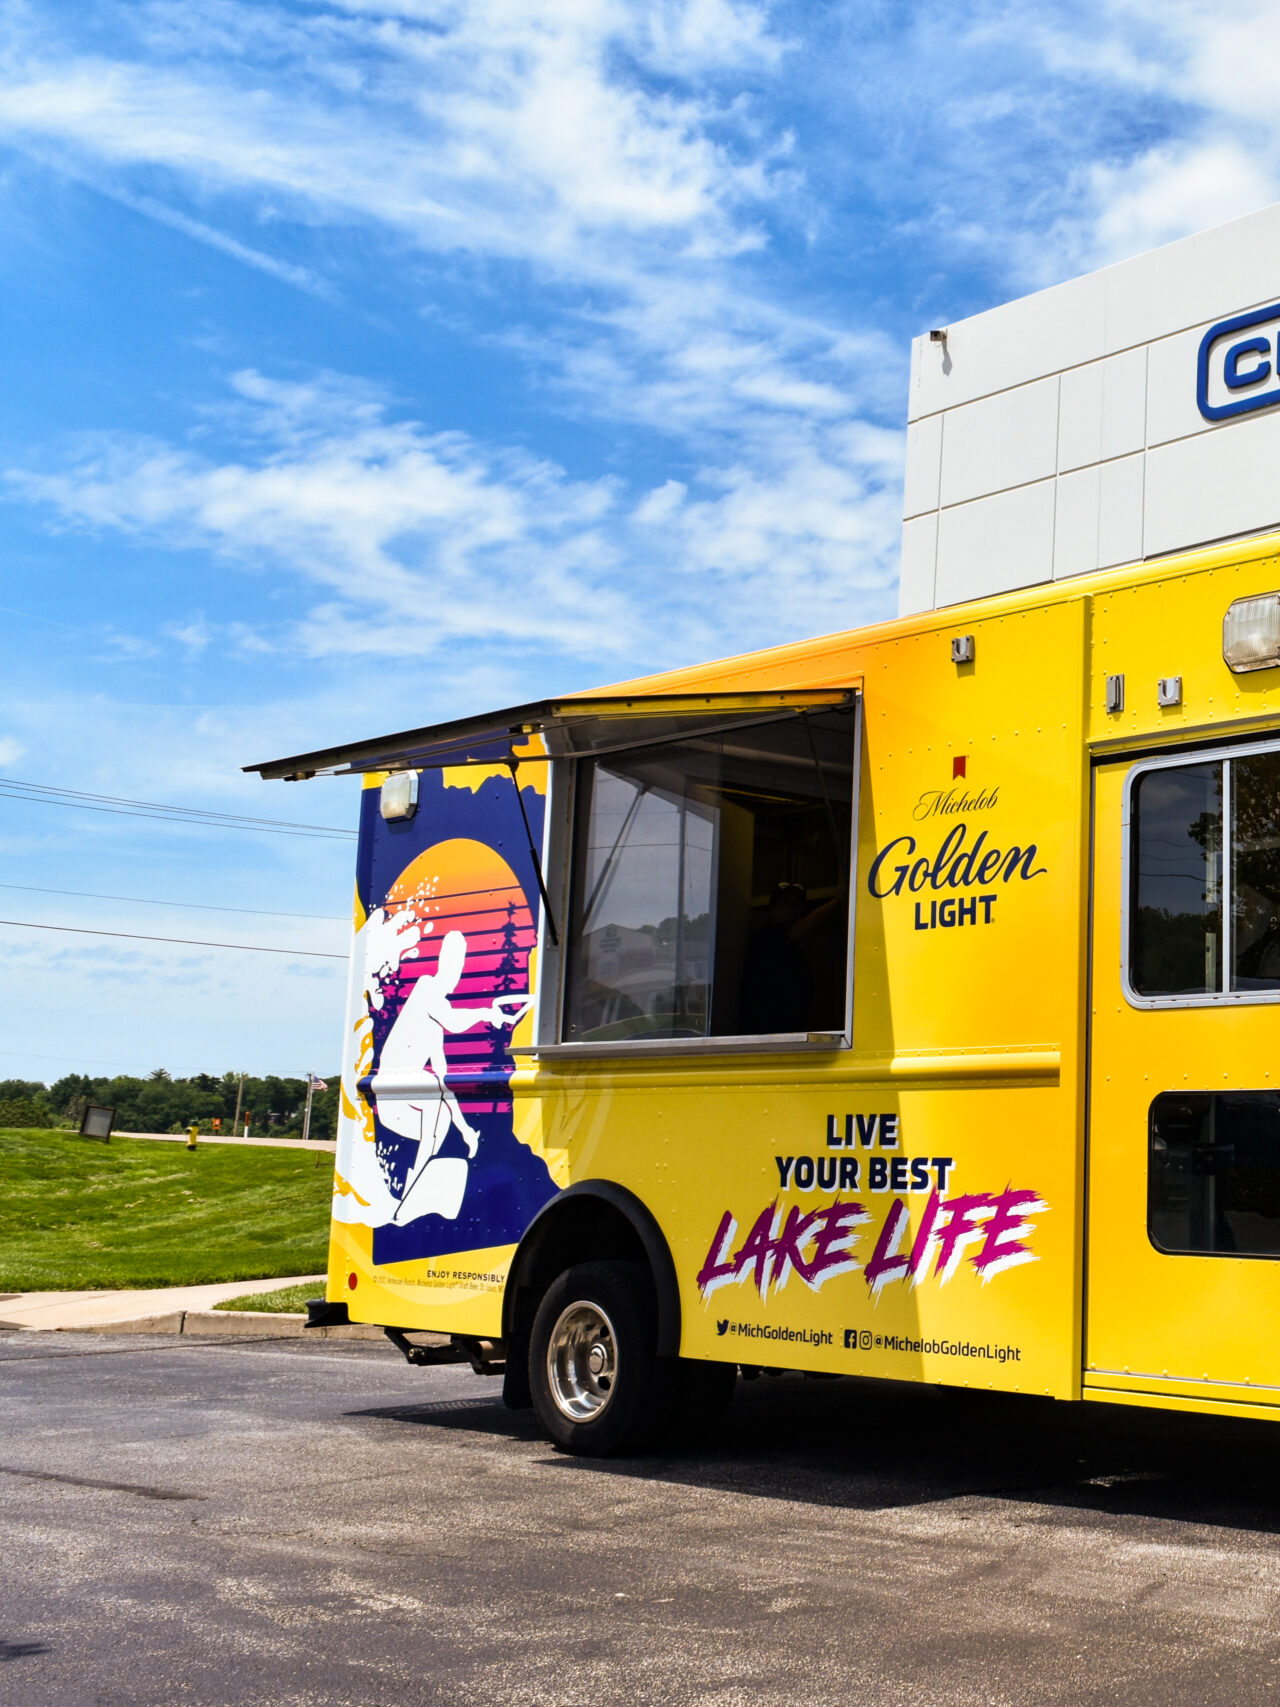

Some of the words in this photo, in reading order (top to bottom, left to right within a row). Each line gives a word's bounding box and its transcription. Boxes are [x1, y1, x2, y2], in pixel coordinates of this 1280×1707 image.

[912, 786, 1000, 822] Michelob
[867, 823, 1048, 899] Golden
[914, 894, 998, 931] LIGHT
[826, 1113, 899, 1149] LIVE
[775, 1156, 860, 1192] YOUR
[868, 1157, 956, 1194] BEST
[696, 1194, 874, 1310] LAKE
[864, 1180, 1051, 1310] LIFE
[426, 1269, 451, 1279] ENJOY
[452, 1271, 505, 1283] RESPONSIBLY
[729, 1322, 833, 1347] @MichGoldenLight
[874, 1334, 1022, 1364] @MichelobGoldenLight
